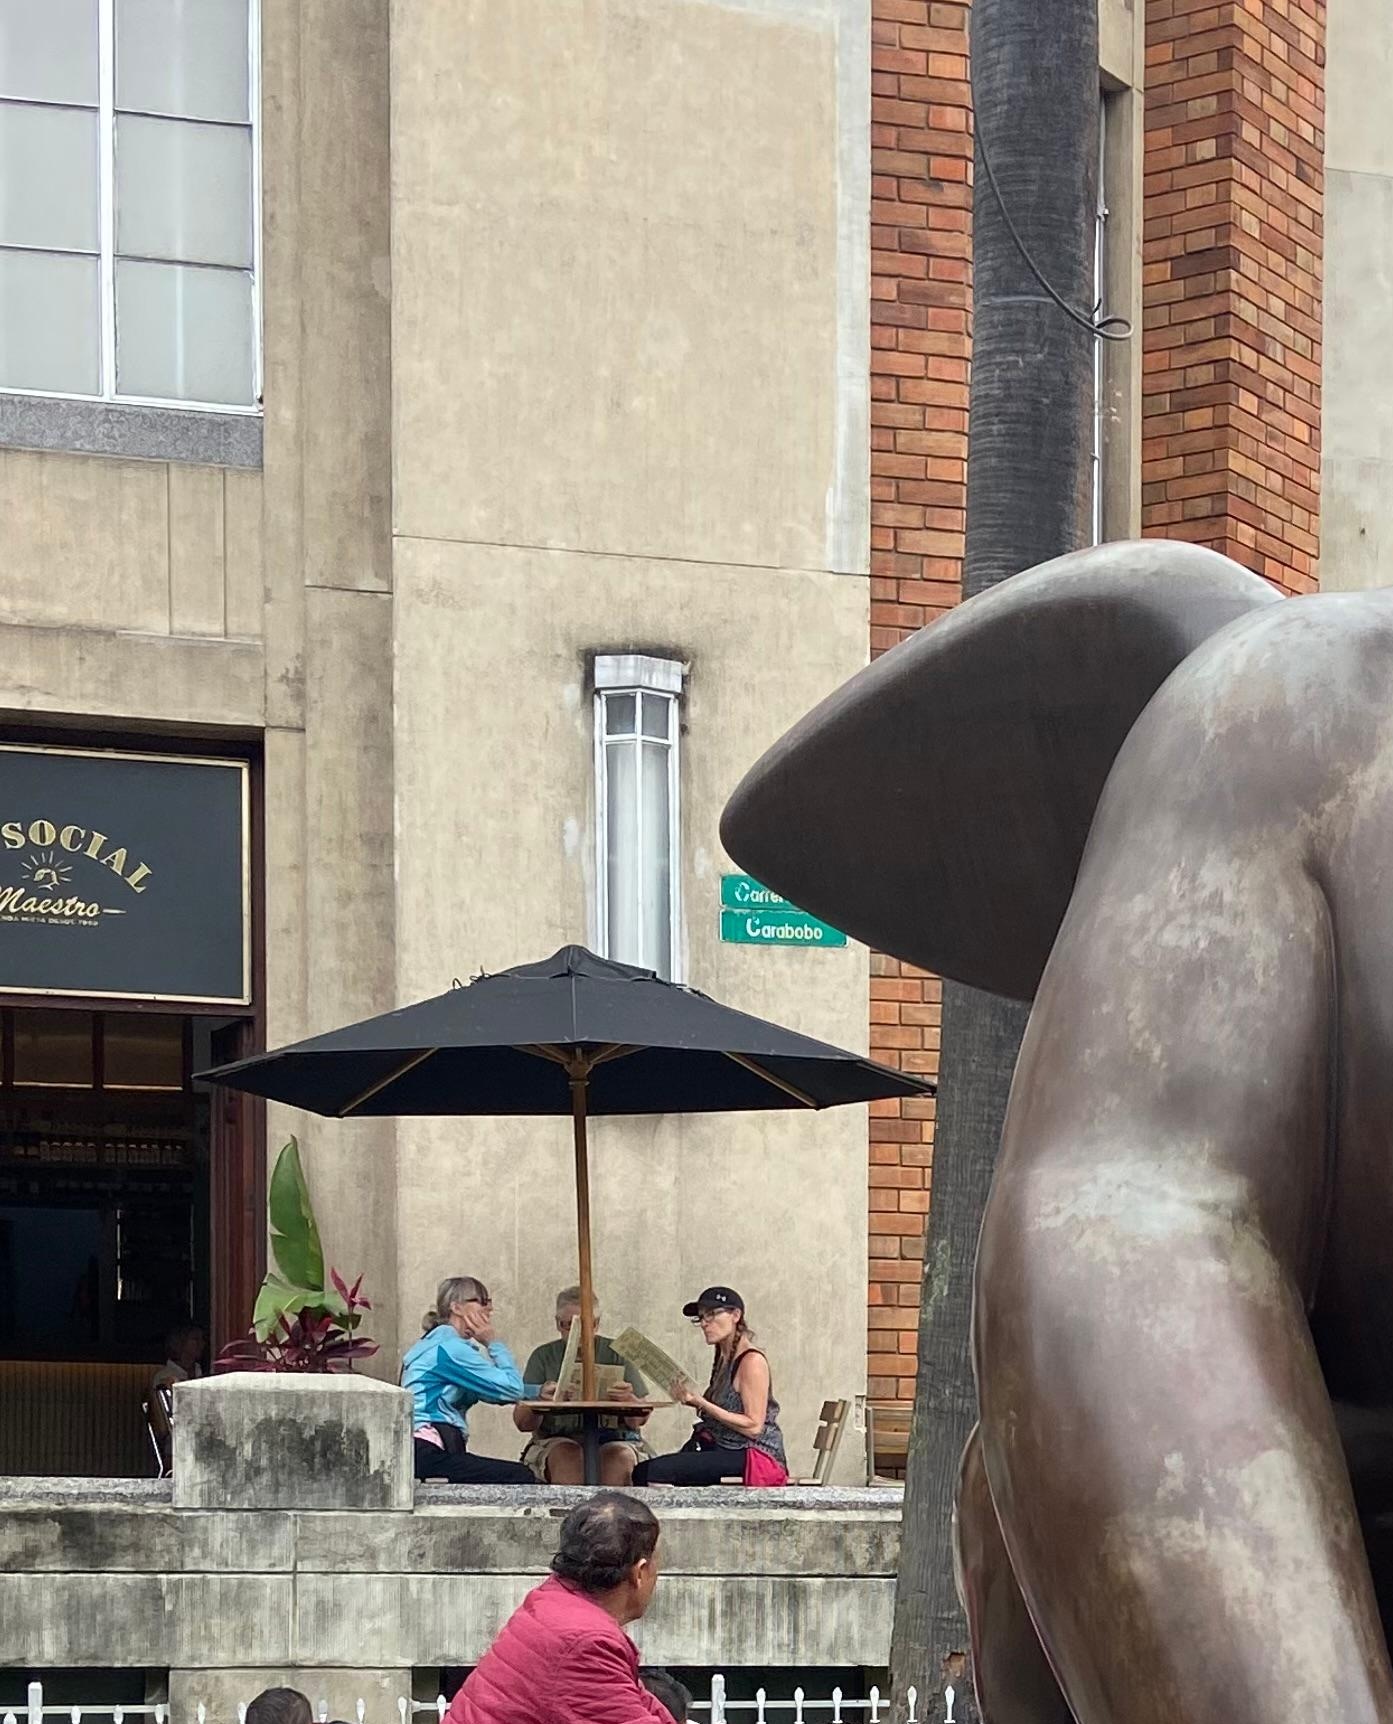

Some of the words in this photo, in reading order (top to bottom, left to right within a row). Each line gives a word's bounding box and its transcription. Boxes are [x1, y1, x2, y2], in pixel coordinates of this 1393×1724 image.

[1, 819, 153, 893] SOCIAL
[0, 886, 100, 917] Maestro
[734, 881, 785, 903] Carre
[746, 917, 823, 940] Carabobo
